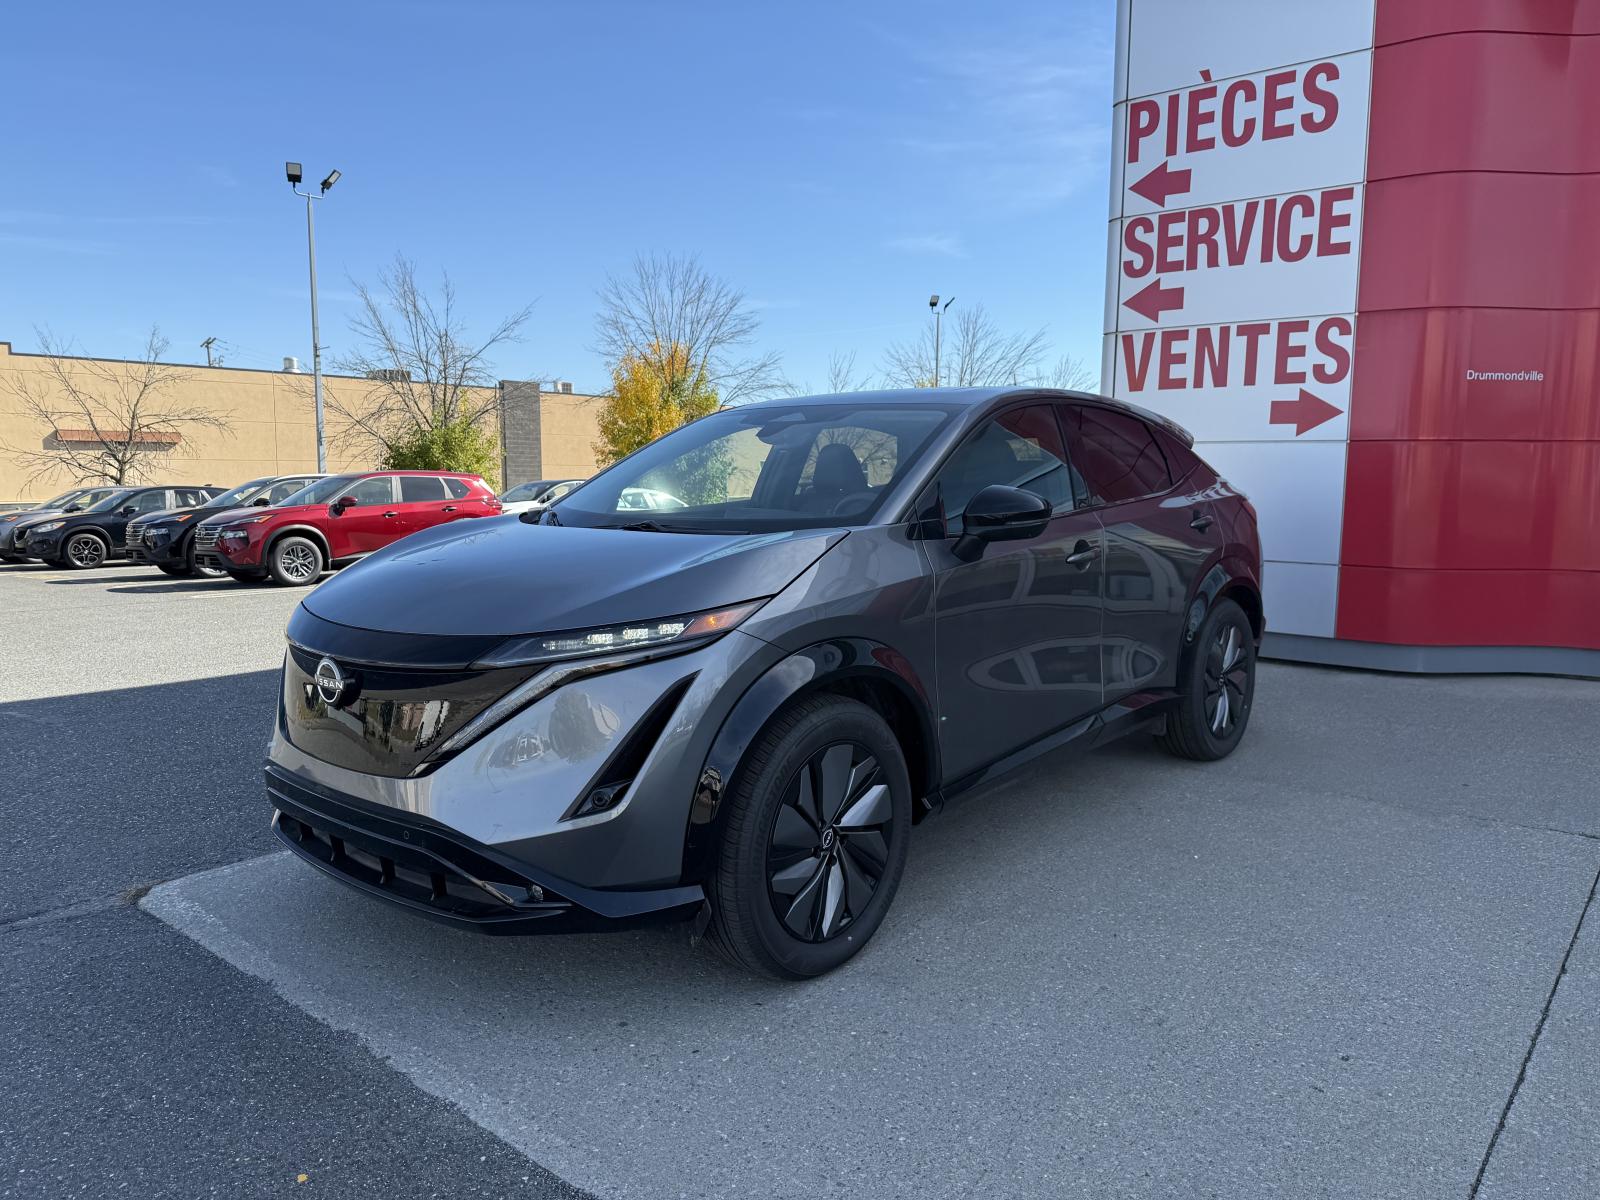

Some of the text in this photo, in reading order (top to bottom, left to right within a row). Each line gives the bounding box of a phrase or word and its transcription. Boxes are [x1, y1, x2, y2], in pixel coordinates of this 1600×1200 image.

[1128, 62, 1340, 163] PIÈCES
[1123, 187, 1354, 278] SERVICE
[1121, 317, 1352, 392] VENTES
[1466, 369, 1544, 381] Drummondville
